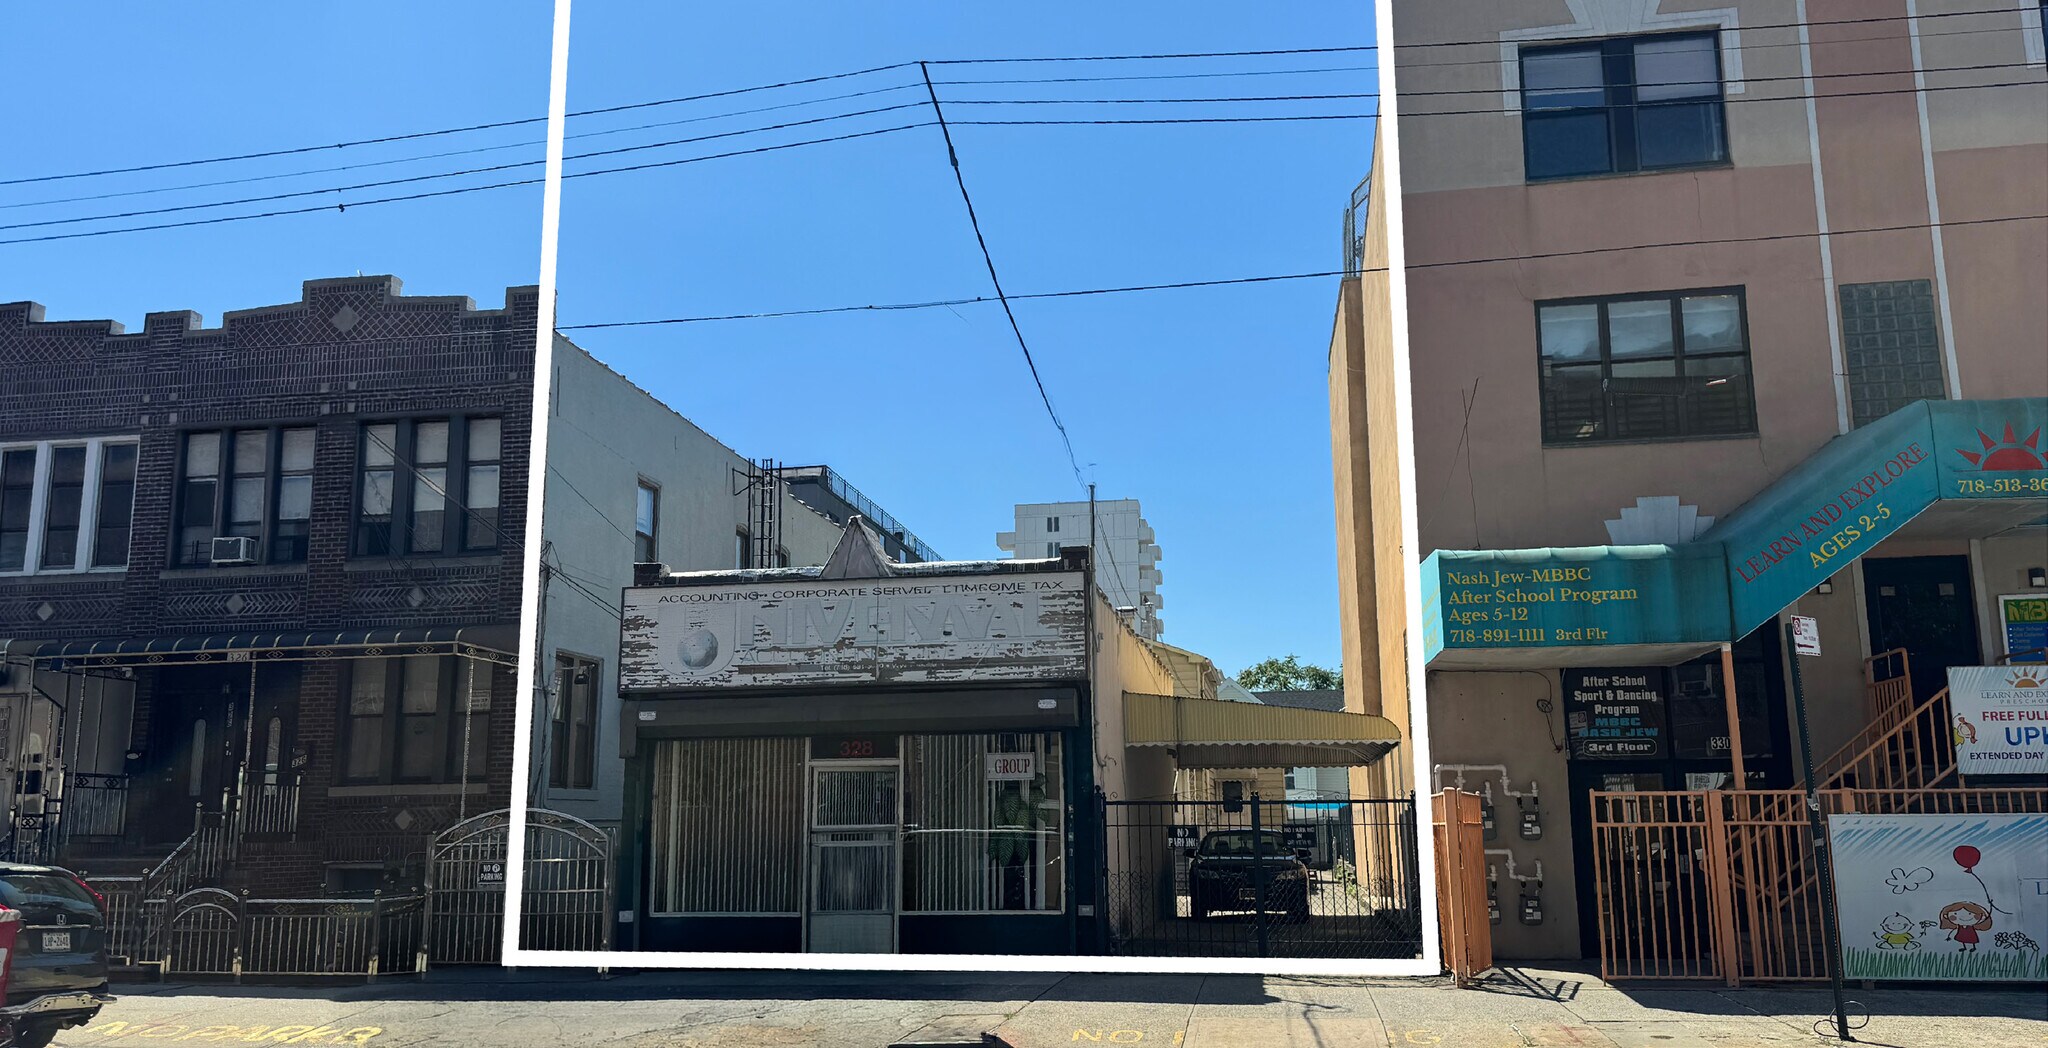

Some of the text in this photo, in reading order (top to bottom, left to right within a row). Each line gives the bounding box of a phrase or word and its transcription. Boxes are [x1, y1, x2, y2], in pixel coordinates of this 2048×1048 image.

[1736, 442, 1928, 583] LEARN AND EXPLORE
[1809, 502, 1891, 569] AGES 2-5
[1447, 567, 1591, 587] Nash Jew-MBBC
[772, 587, 867, 599] CORPORATE
[1032, 580, 1063, 590] TAX
[1448, 587, 1637, 605] After School Program
[1448, 607, 1528, 625] Ages 5-12
[1450, 627, 1608, 643] 718-891-1111 3rd Flr
[230, 652, 248, 662] 326
[1582, 675, 1647, 687] After School
[1573, 689, 1657, 703] Sport & Dancing
[1981, 691, 2011, 699] LEARN
[1594, 704, 1640, 716] Program
[1982, 711, 2015, 721] FREE
[1595, 717, 1641, 726] MBBC
[1578, 727, 1659, 737] NASH JEW
[840, 741, 873, 756] 328
[1588, 743, 1651, 752] 3rd Floor
[1711, 736, 1731, 750] 330
[1970, 751, 2044, 760] EXTENDED DAY
[995, 758, 1030, 774] GROUP
[1177, 828, 1189, 837] NO
[483, 864, 491, 872] NO
[480, 872, 503, 881] PARKING
[1071, 1027, 1143, 1044] NO
